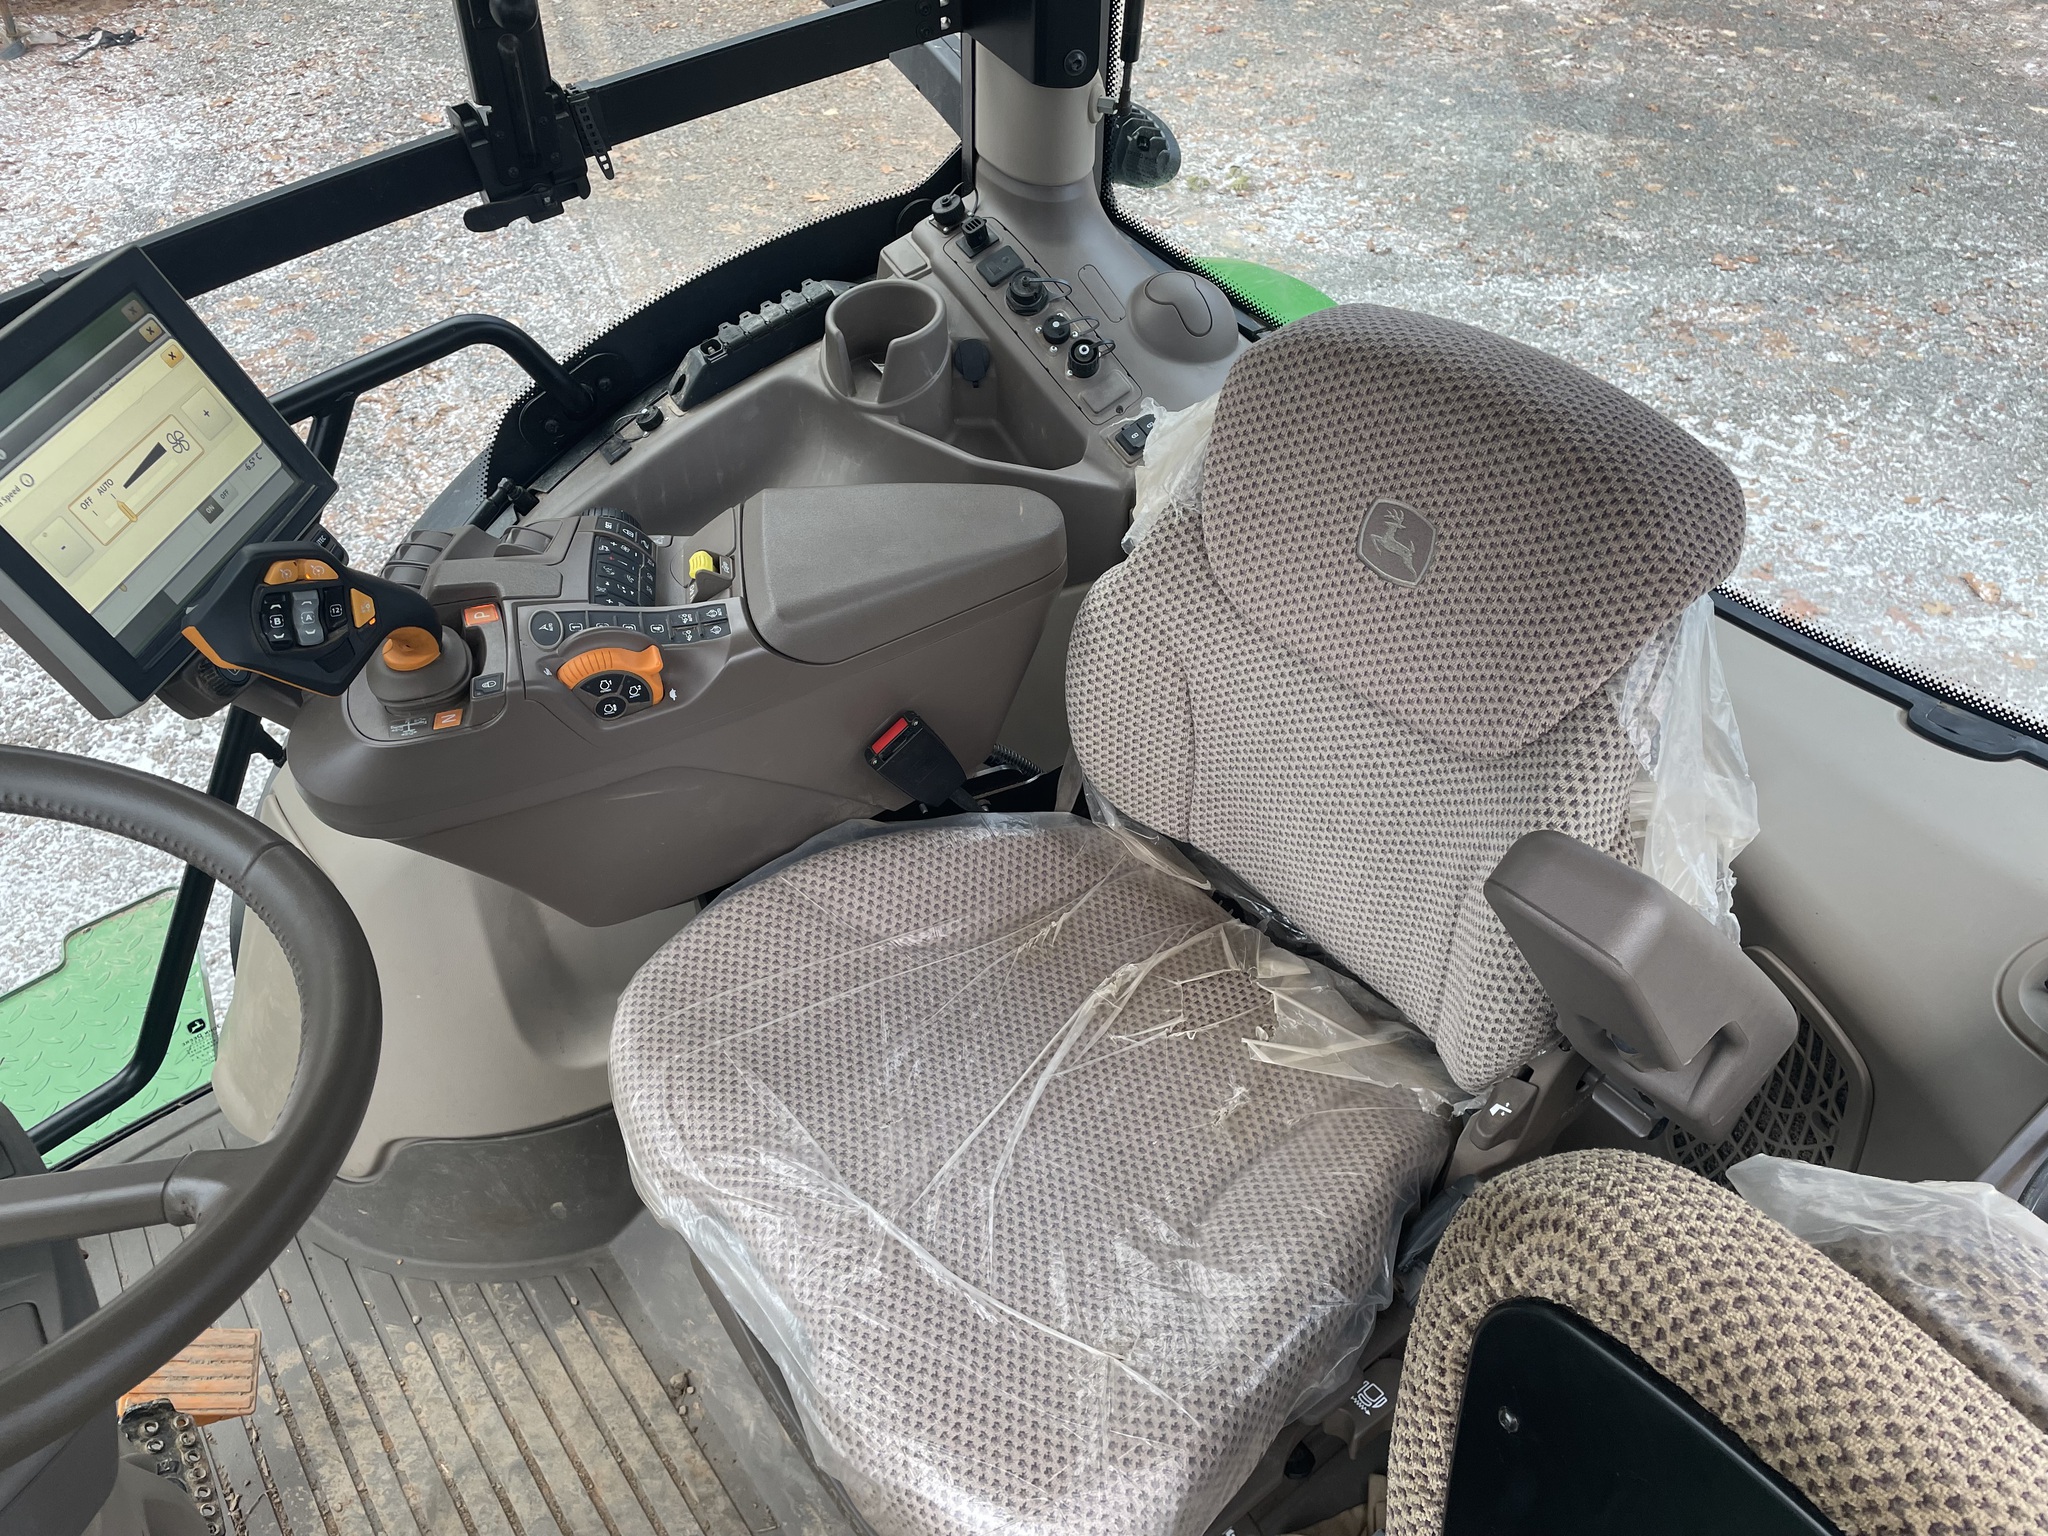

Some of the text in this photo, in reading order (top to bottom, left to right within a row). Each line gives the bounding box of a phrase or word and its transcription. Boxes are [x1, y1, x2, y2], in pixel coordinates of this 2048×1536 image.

[96, 478, 114, 495] AUTO
[2, 485, 21, 504] Speed
[220, 489, 229, 500] OFF
[80, 496, 93, 510] OFF
[205, 504, 215, 514] ON
[473, 611, 490, 619] P
[273, 617, 281, 625] B
[441, 713, 456, 724] N
